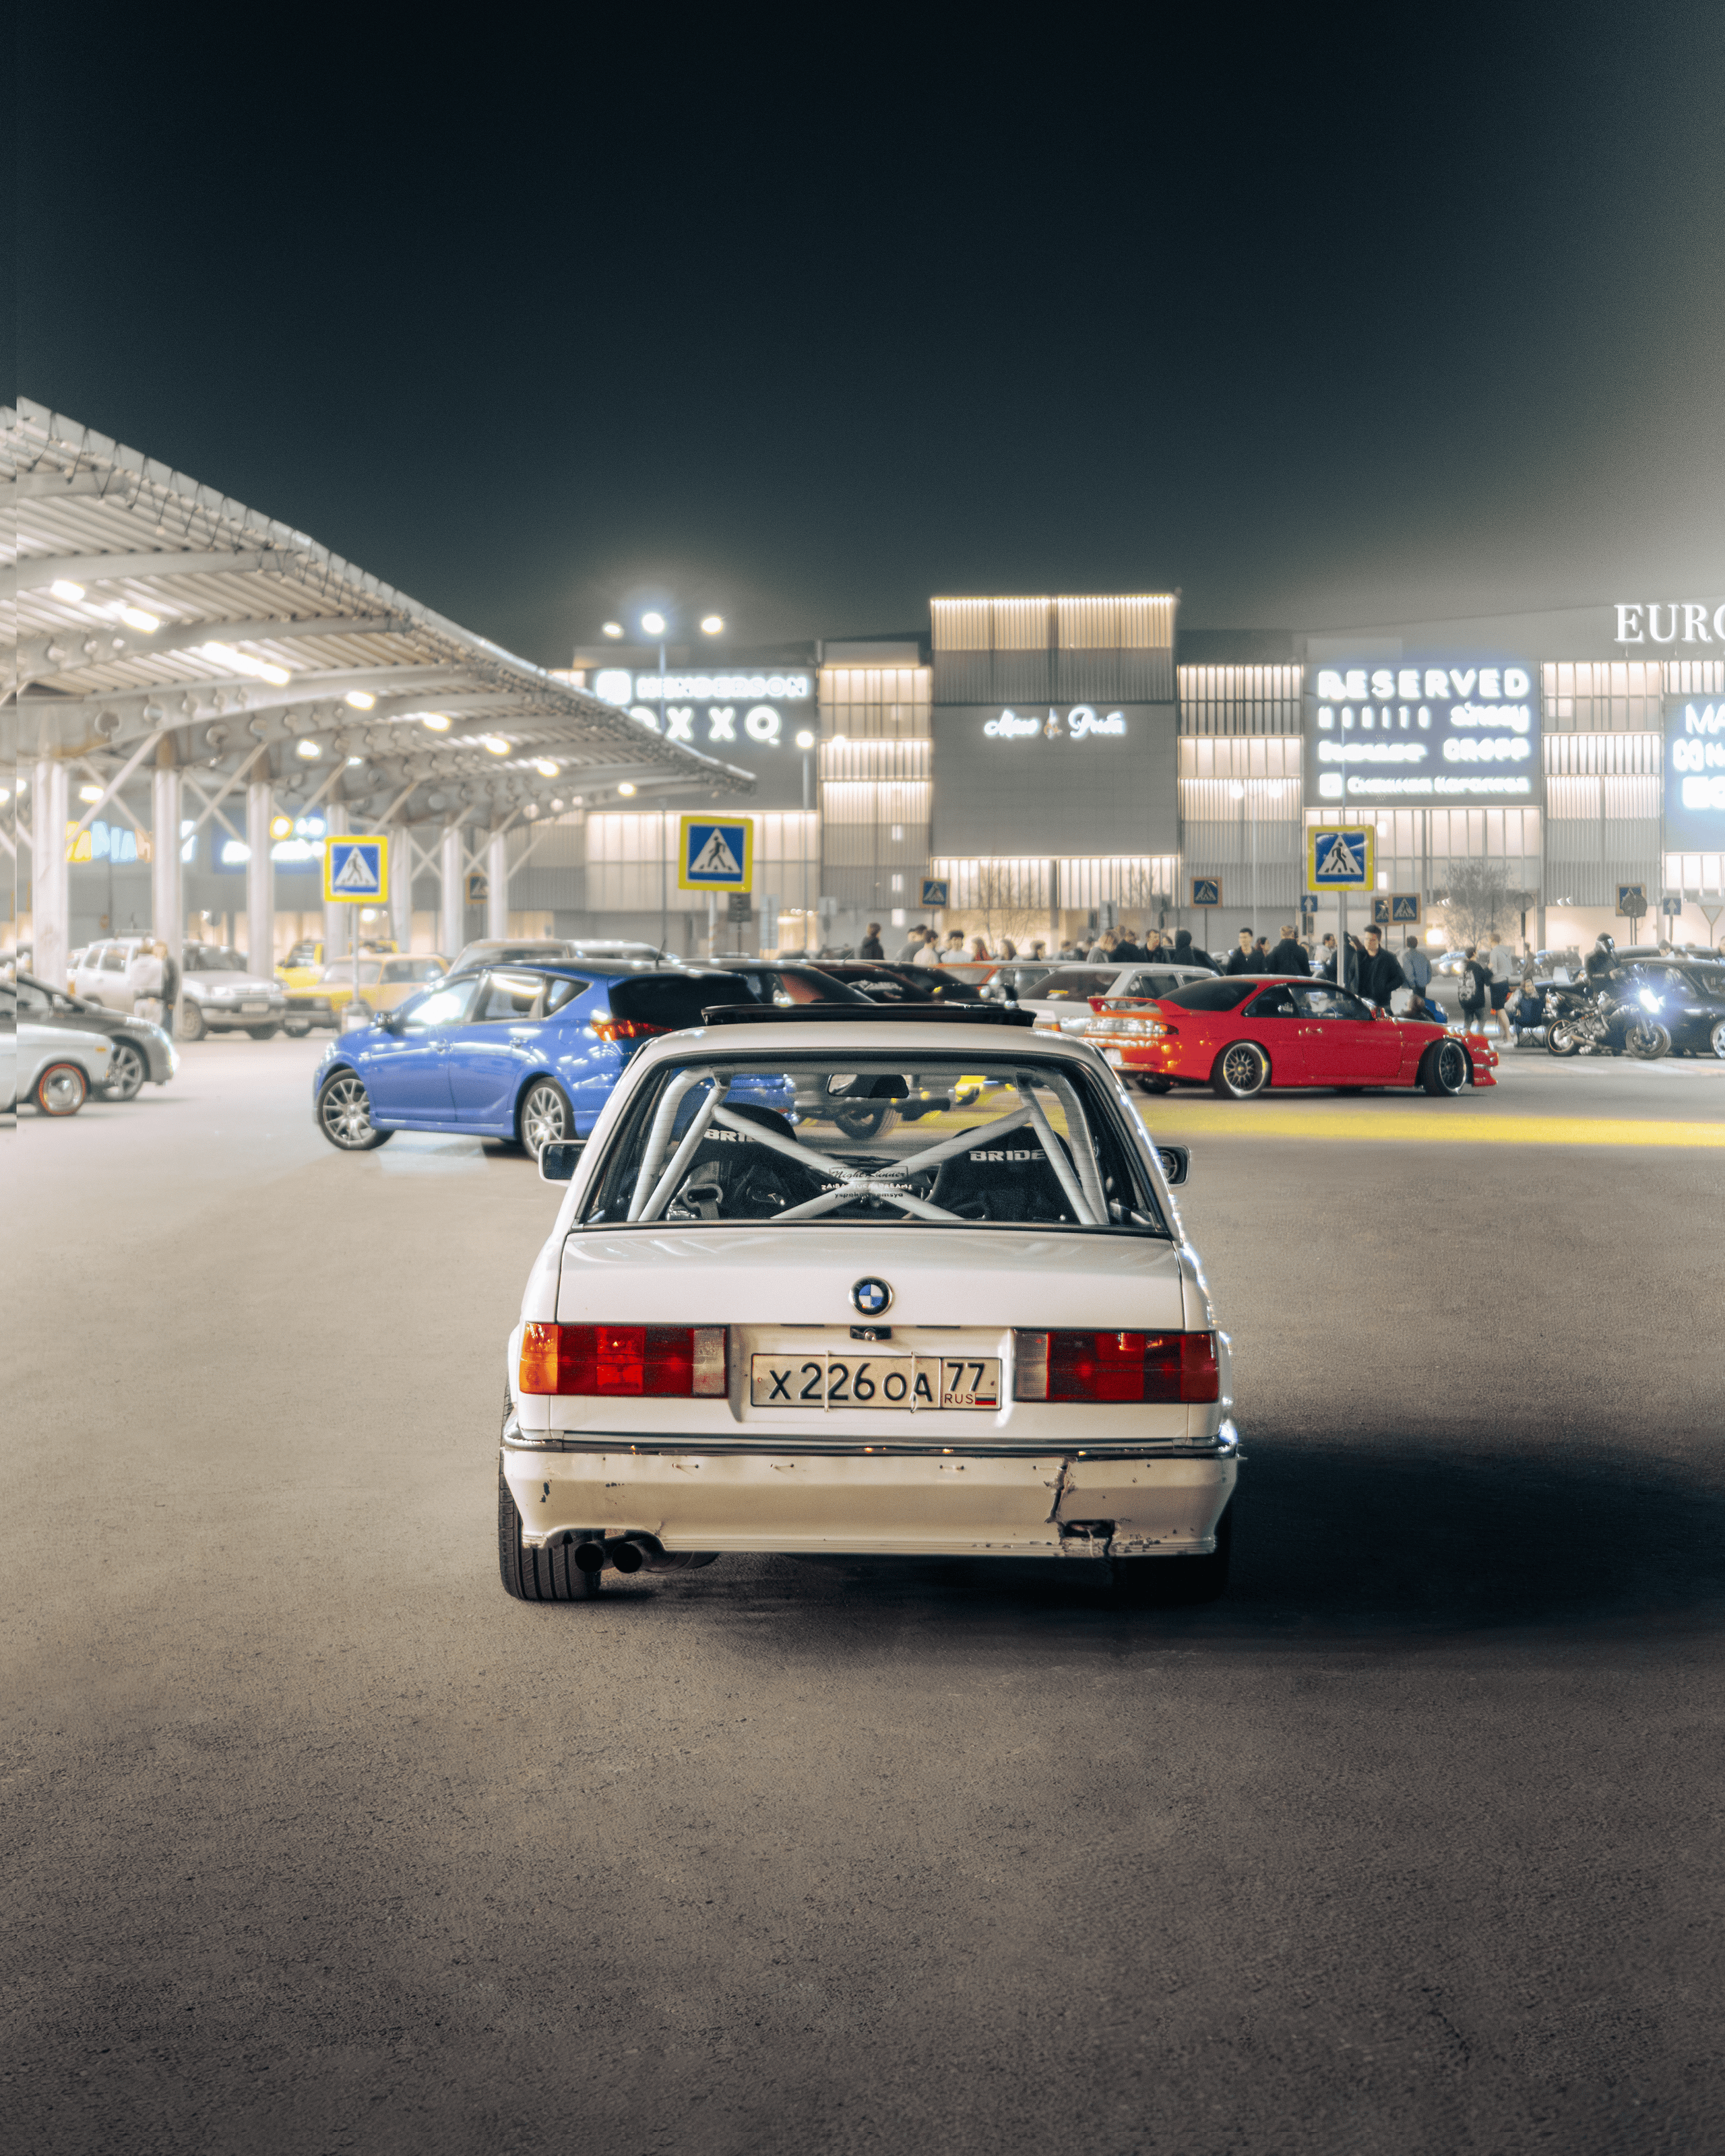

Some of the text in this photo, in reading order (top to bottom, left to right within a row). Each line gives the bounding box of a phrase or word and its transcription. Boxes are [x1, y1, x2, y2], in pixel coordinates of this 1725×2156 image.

[637, 677, 807, 699] HENDERSON
[1319, 669, 1530, 699] RESERVED
[969, 1149, 1046, 1161] BRIDE
[947, 1362, 985, 1391] 77
[944, 1393, 974, 1404] RUS
